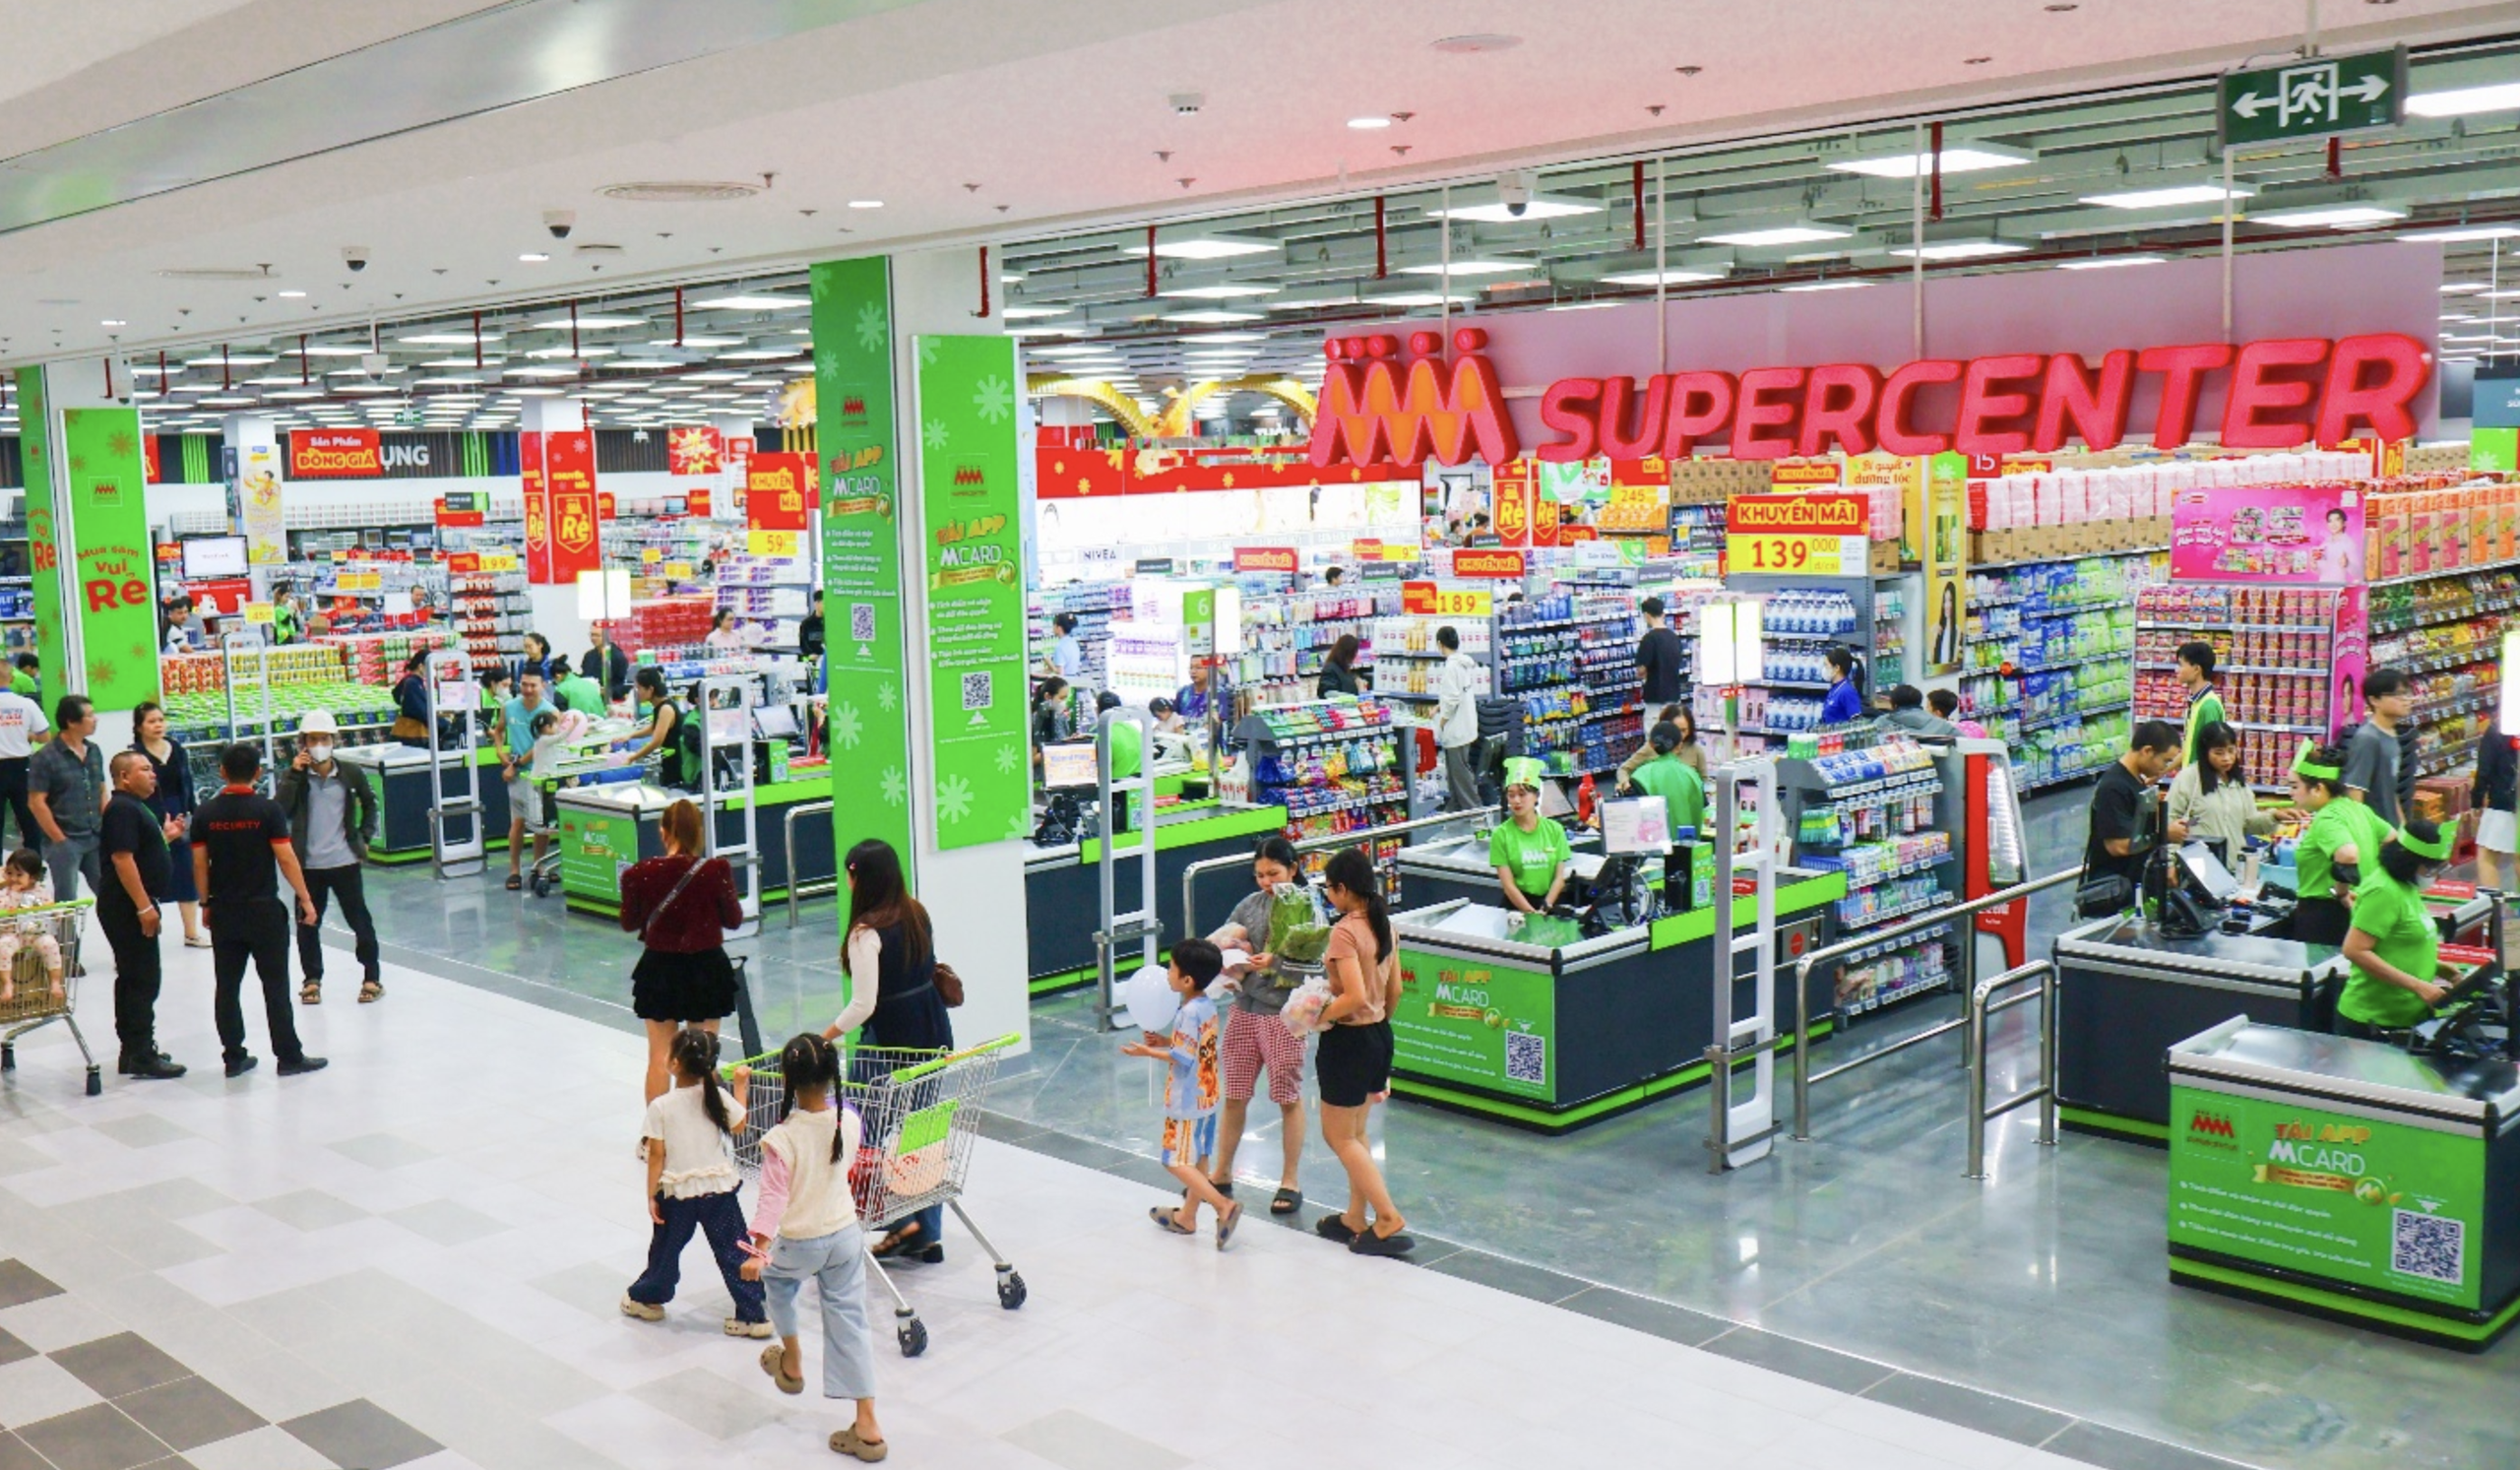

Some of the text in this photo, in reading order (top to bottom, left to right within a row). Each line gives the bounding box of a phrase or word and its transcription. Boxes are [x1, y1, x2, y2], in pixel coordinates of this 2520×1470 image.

[1537, 333, 2432, 463] SUPERCENTER
[297, 448, 377, 469] ĐỒNG GIÁ
[1973, 454, 1996, 472] 15
[750, 467, 793, 490] KHUYẾN
[780, 489, 801, 511] MÃI
[1621, 488, 1646, 502] 245
[1737, 497, 1858, 525] KHUYẾN MÃI
[767, 535, 784, 552] 59
[1752, 540, 1808, 568] 139
[1084, 549, 1116, 560] NIVEA
[85, 572, 148, 613] Rẻ
[1197, 597, 1209, 616] 6
[1439, 595, 1477, 613] 189
[209, 819, 262, 832] SECURITY
[2275, 1118, 2371, 1145] TẢI APP
